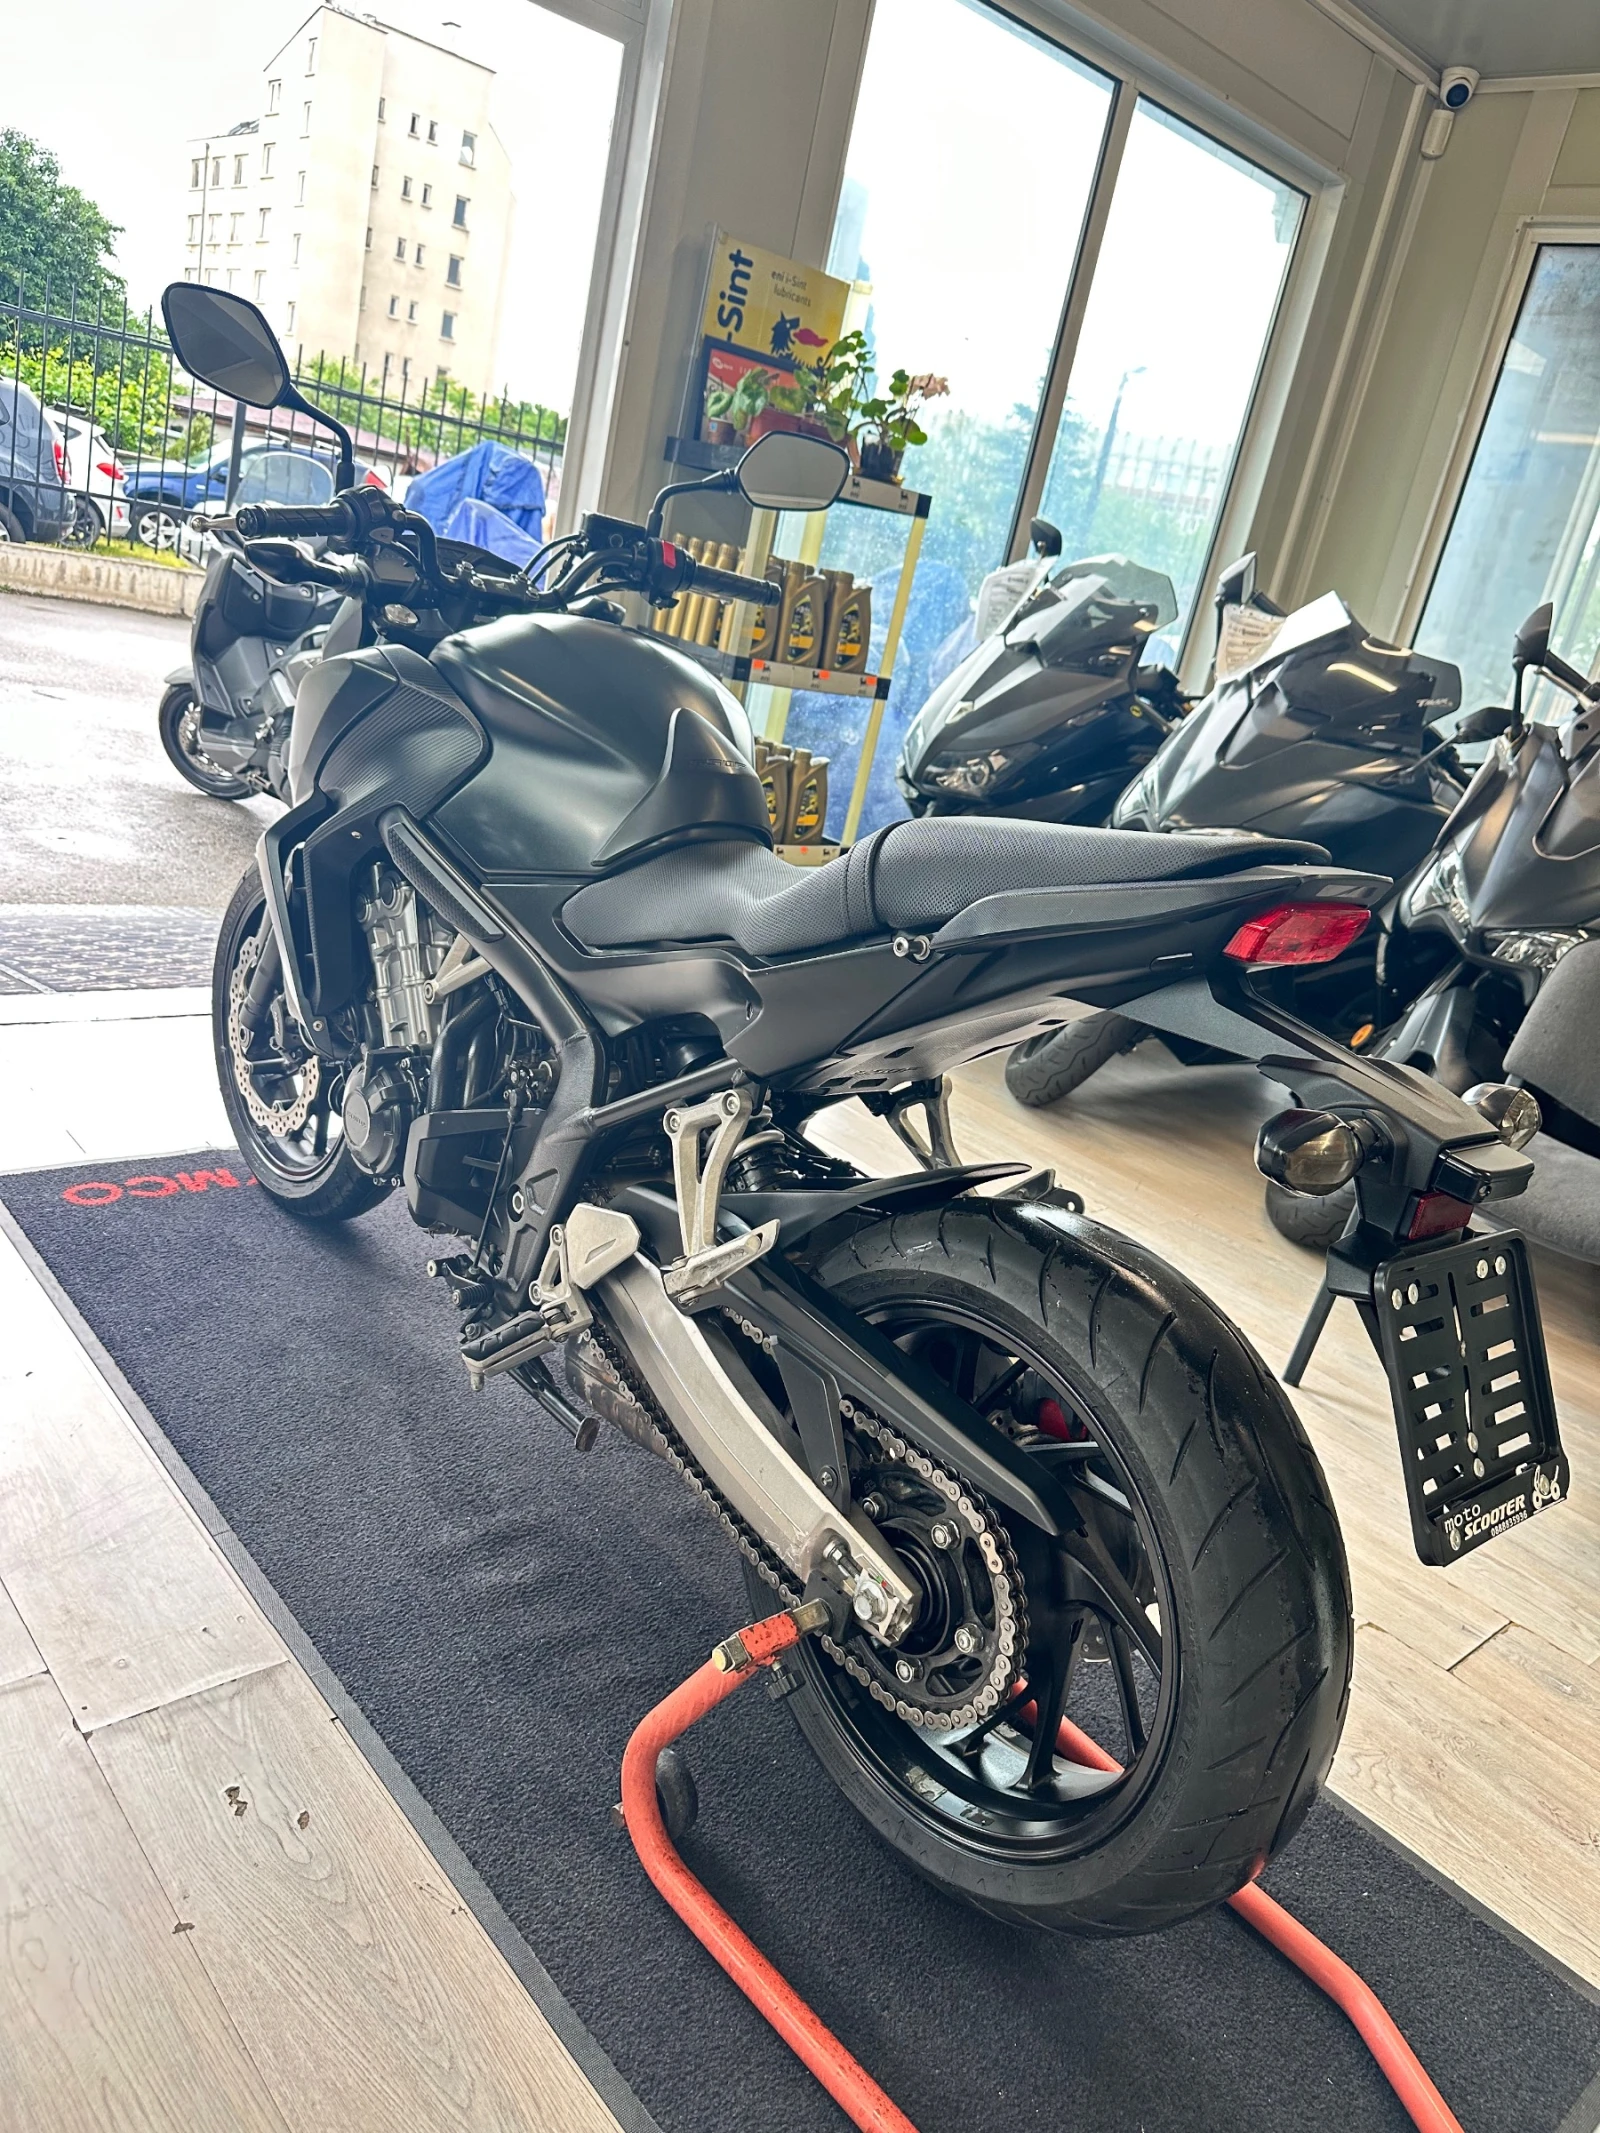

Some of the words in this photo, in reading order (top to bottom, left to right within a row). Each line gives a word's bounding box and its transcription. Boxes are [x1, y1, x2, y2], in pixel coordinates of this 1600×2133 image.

[773, 283, 812, 307] lubricants
[62, 1167, 258, 1207] MCO
[1444, 1504, 1481, 1534] moto
[1464, 1494, 1526, 1541] SCOOTER
